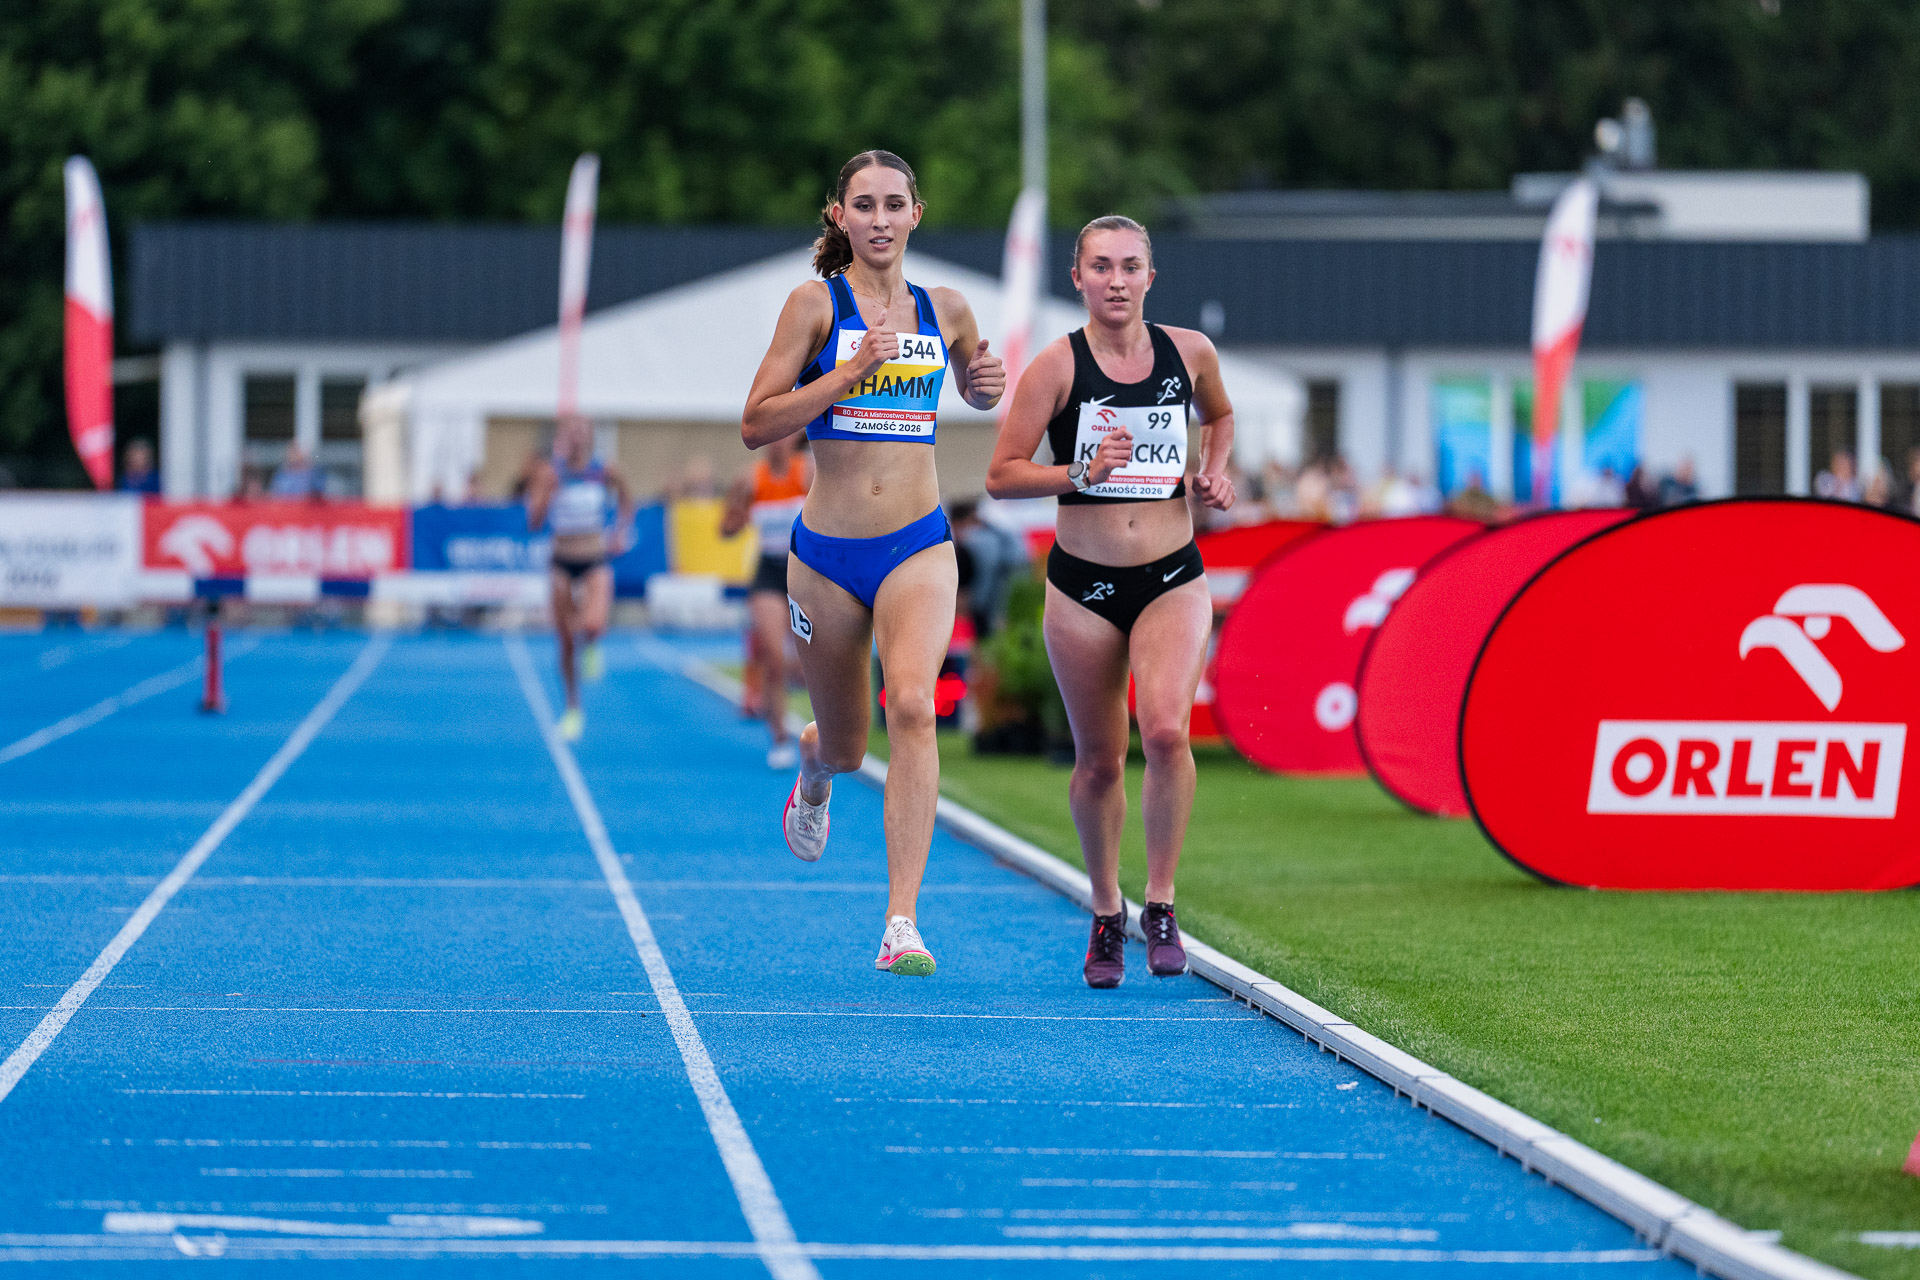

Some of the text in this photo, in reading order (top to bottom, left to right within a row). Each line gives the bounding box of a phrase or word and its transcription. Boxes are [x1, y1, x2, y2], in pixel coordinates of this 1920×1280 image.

[902, 339, 936, 360] 544
[848, 375, 935, 399] HAMM
[853, 410, 869, 418] PZLA
[869, 411, 905, 419] Mistrzostwa
[1148, 412, 1172, 430] 99
[854, 421, 921, 433] ZAMOŚĆ 2026
[1096, 485, 1163, 495] ZAMOŚĆ 2026
[789, 603, 812, 636] 15
[1610, 737, 1882, 802] ORLEN
